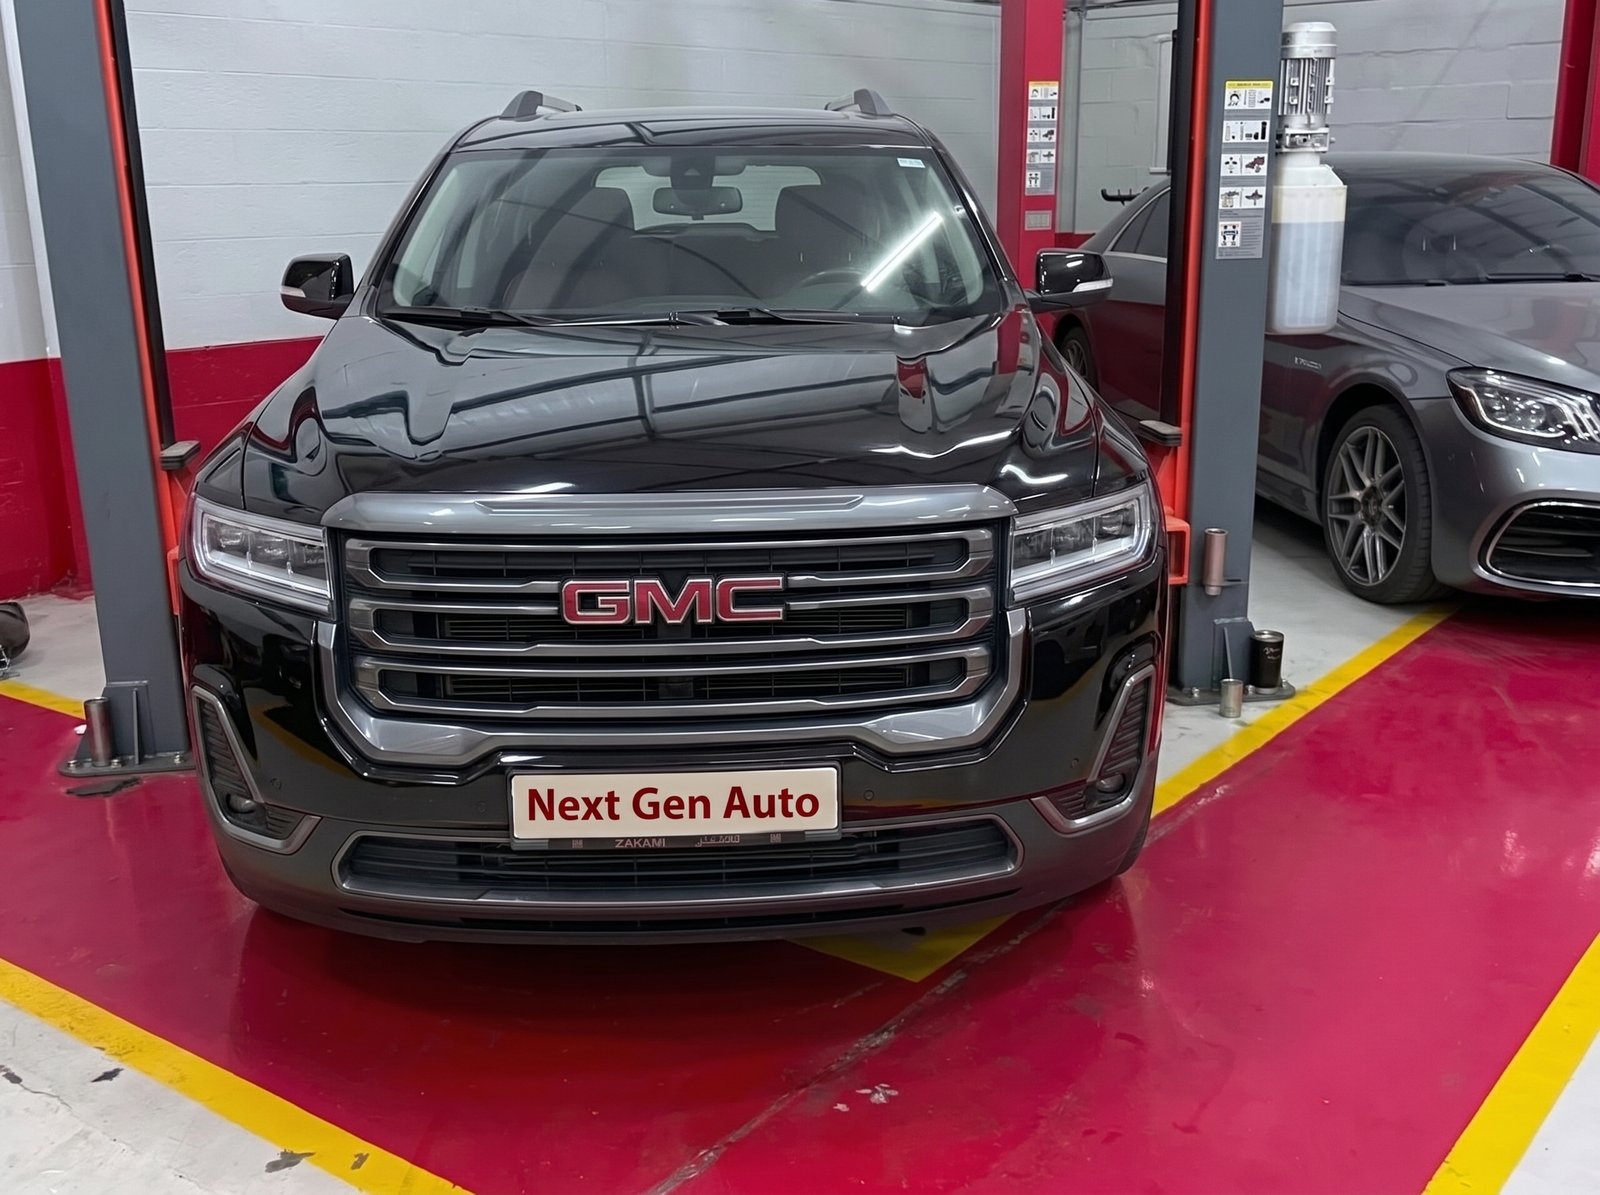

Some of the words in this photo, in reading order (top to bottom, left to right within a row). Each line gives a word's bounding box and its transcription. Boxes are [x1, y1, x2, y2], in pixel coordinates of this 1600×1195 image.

[562, 577, 784, 624] GMC
[528, 788, 620, 821] Next
[632, 787, 711, 820] Gen
[723, 786, 820, 819] Auto
